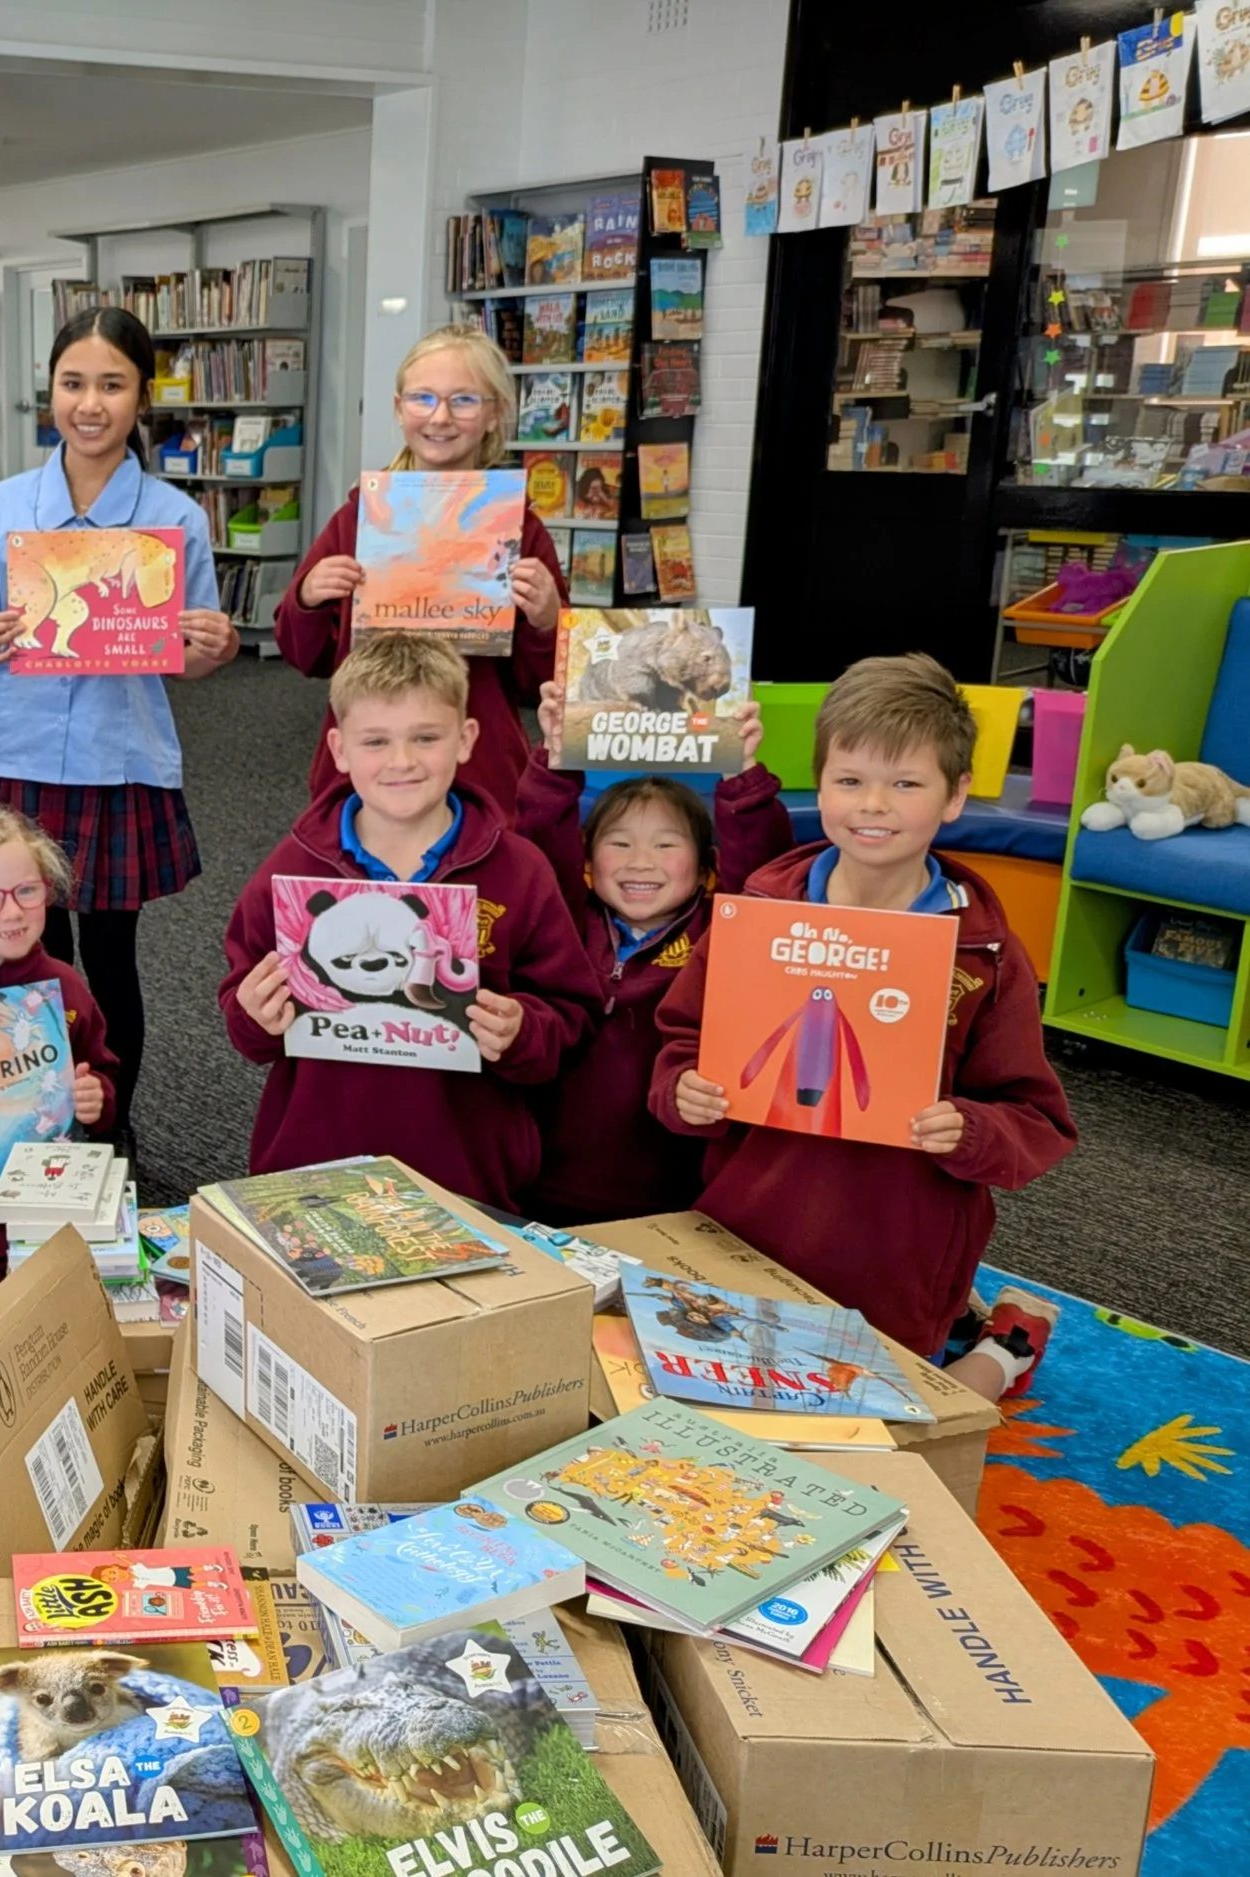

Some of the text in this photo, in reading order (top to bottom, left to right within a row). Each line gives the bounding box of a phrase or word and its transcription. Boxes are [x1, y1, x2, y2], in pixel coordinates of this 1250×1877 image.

[594, 214, 638, 232] RAIN
[592, 252, 636, 268] ROCK
[92, 617, 168, 631] DINOSAURS
[374, 597, 503, 627] mallee sky
[104, 644, 146, 656] SMALL
[117, 633, 137, 643] ARE
[25, 660, 111, 669] CHARLOTTE
[591, 711, 709, 733] GEORGE THE
[586, 735, 719, 762] WOMBAT
[790, 922, 817, 939] Oh
[770, 936, 891, 971] GEORGE!
[343, 1044, 417, 1058] Matt Stanton
[341, 1191, 438, 1262] RAINFOREST
[14, 1325, 45, 1362] Penguin
[19, 1321, 68, 1382] Random House
[83, 1360, 117, 1405] HANDLE
[654, 1350, 841, 1394] SNEER
[86, 1376, 129, 1432] WITH CARE
[400, 1377, 585, 1437] HarperCollinsPublishers
[187, 1379, 210, 1468] tainable Packaging
[424, 1405, 546, 1447] www.harpercollins.com.au
[642, 1410, 869, 1518] ILLUSTRATED
[279, 1461, 296, 1514] of books
[36, 1583, 82, 1619] Little
[59, 1577, 114, 1617] ASH
[254, 1584, 270, 1618] SHANNON
[892, 1543, 1033, 1706] HANDLE WITH
[264, 1640, 278, 1660] DEAN
[268, 1660, 280, 1681] HALE
[710, 1637, 764, 1720] ony Snicket
[238, 1714, 253, 1731] 2
[14, 1756, 161, 1794] ELSA THE
[2, 1785, 189, 1836] KOALA
[386, 1810, 547, 1877] ELVIS THE
[785, 1836, 1121, 1870] HarperCollinsPublishers
